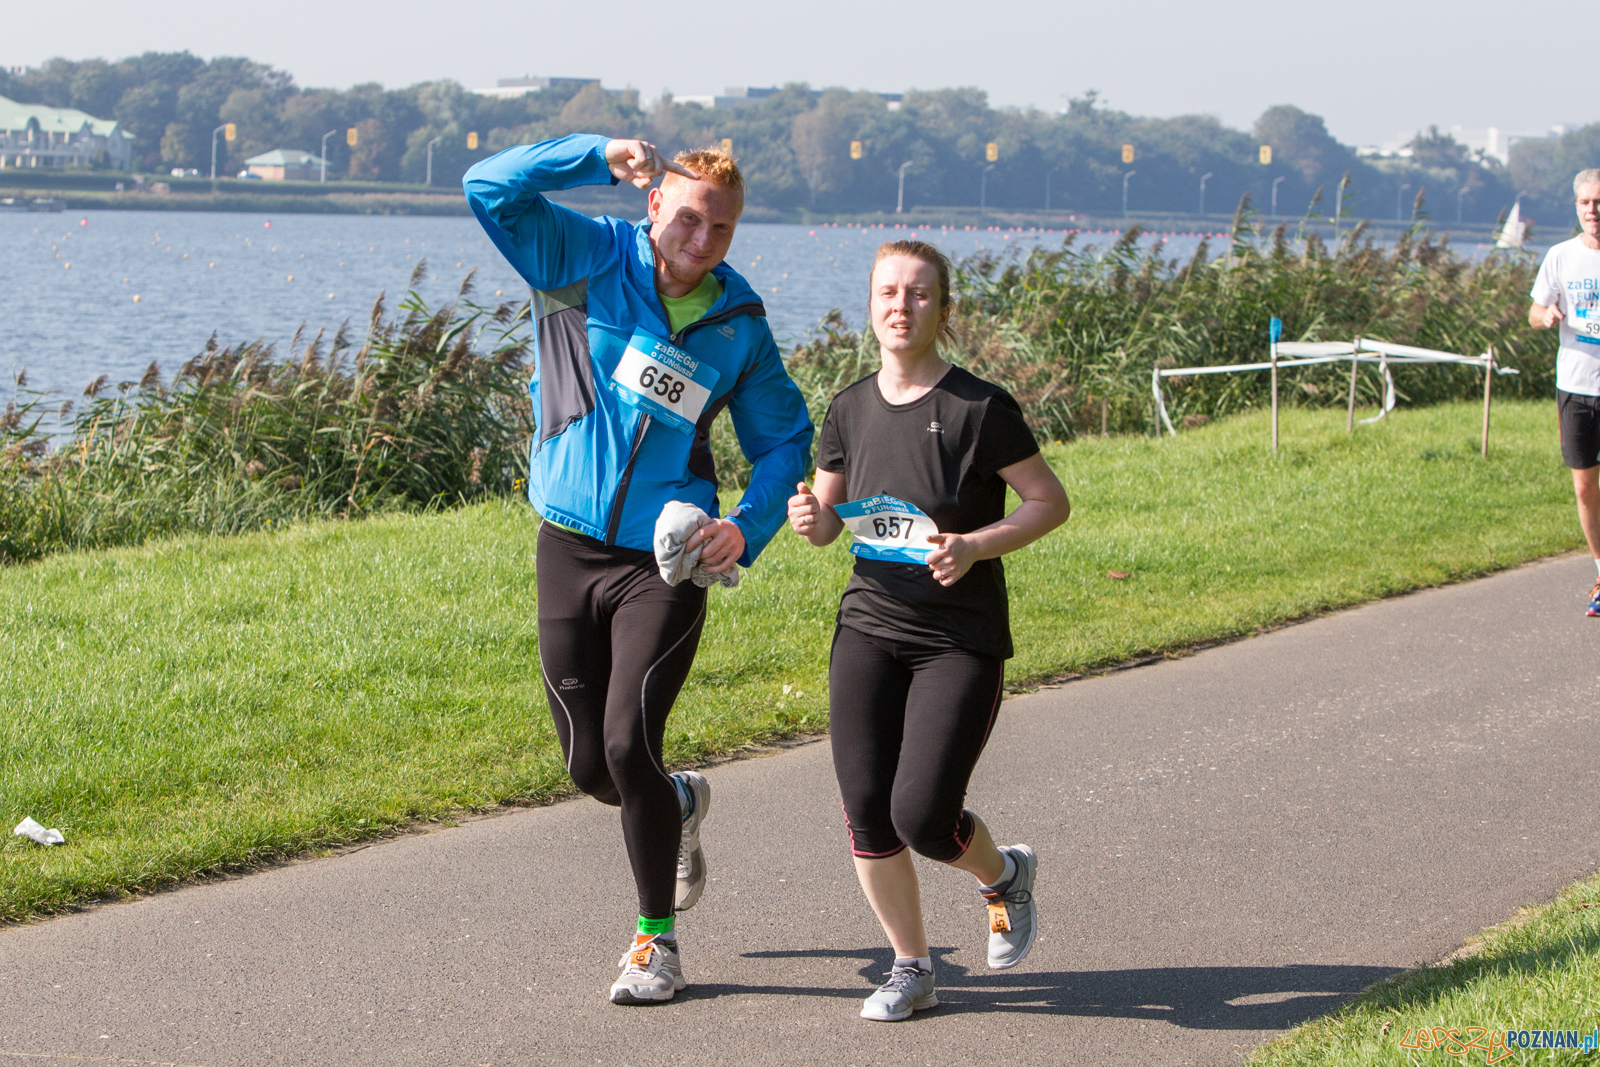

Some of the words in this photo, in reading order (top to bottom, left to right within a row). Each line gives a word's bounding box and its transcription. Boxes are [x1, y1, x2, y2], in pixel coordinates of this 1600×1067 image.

[1567, 278, 1600, 290] zaBI
[654, 341, 699, 372] zaBIEGaj
[657, 353, 694, 378] FUNdusze
[639, 365, 685, 404] 658
[872, 515, 914, 540] 657
